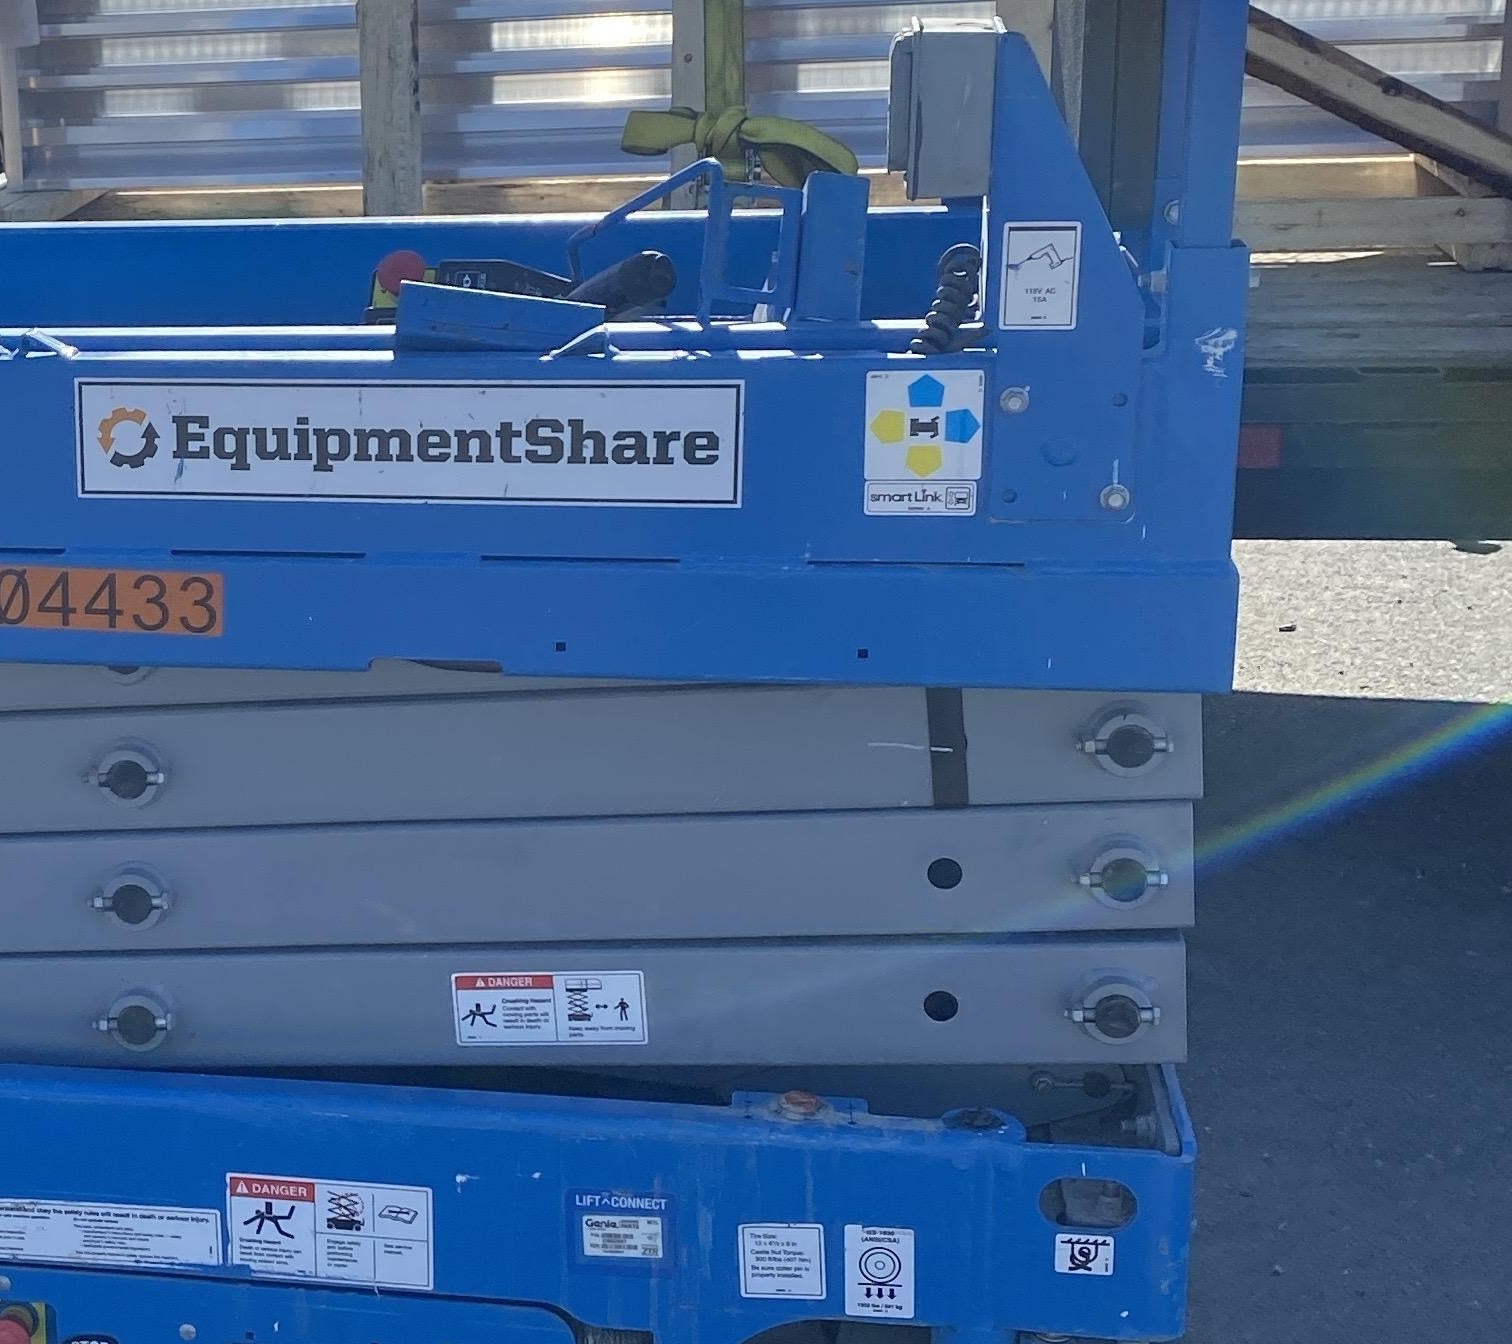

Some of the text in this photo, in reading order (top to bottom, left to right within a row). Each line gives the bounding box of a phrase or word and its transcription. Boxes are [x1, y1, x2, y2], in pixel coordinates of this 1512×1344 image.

[171, 414, 721, 472] EquipmentShare
[488, 976, 533, 988] DANGER
[252, 1182, 307, 1198] DANGER
[584, 1218, 617, 1229] Genie
